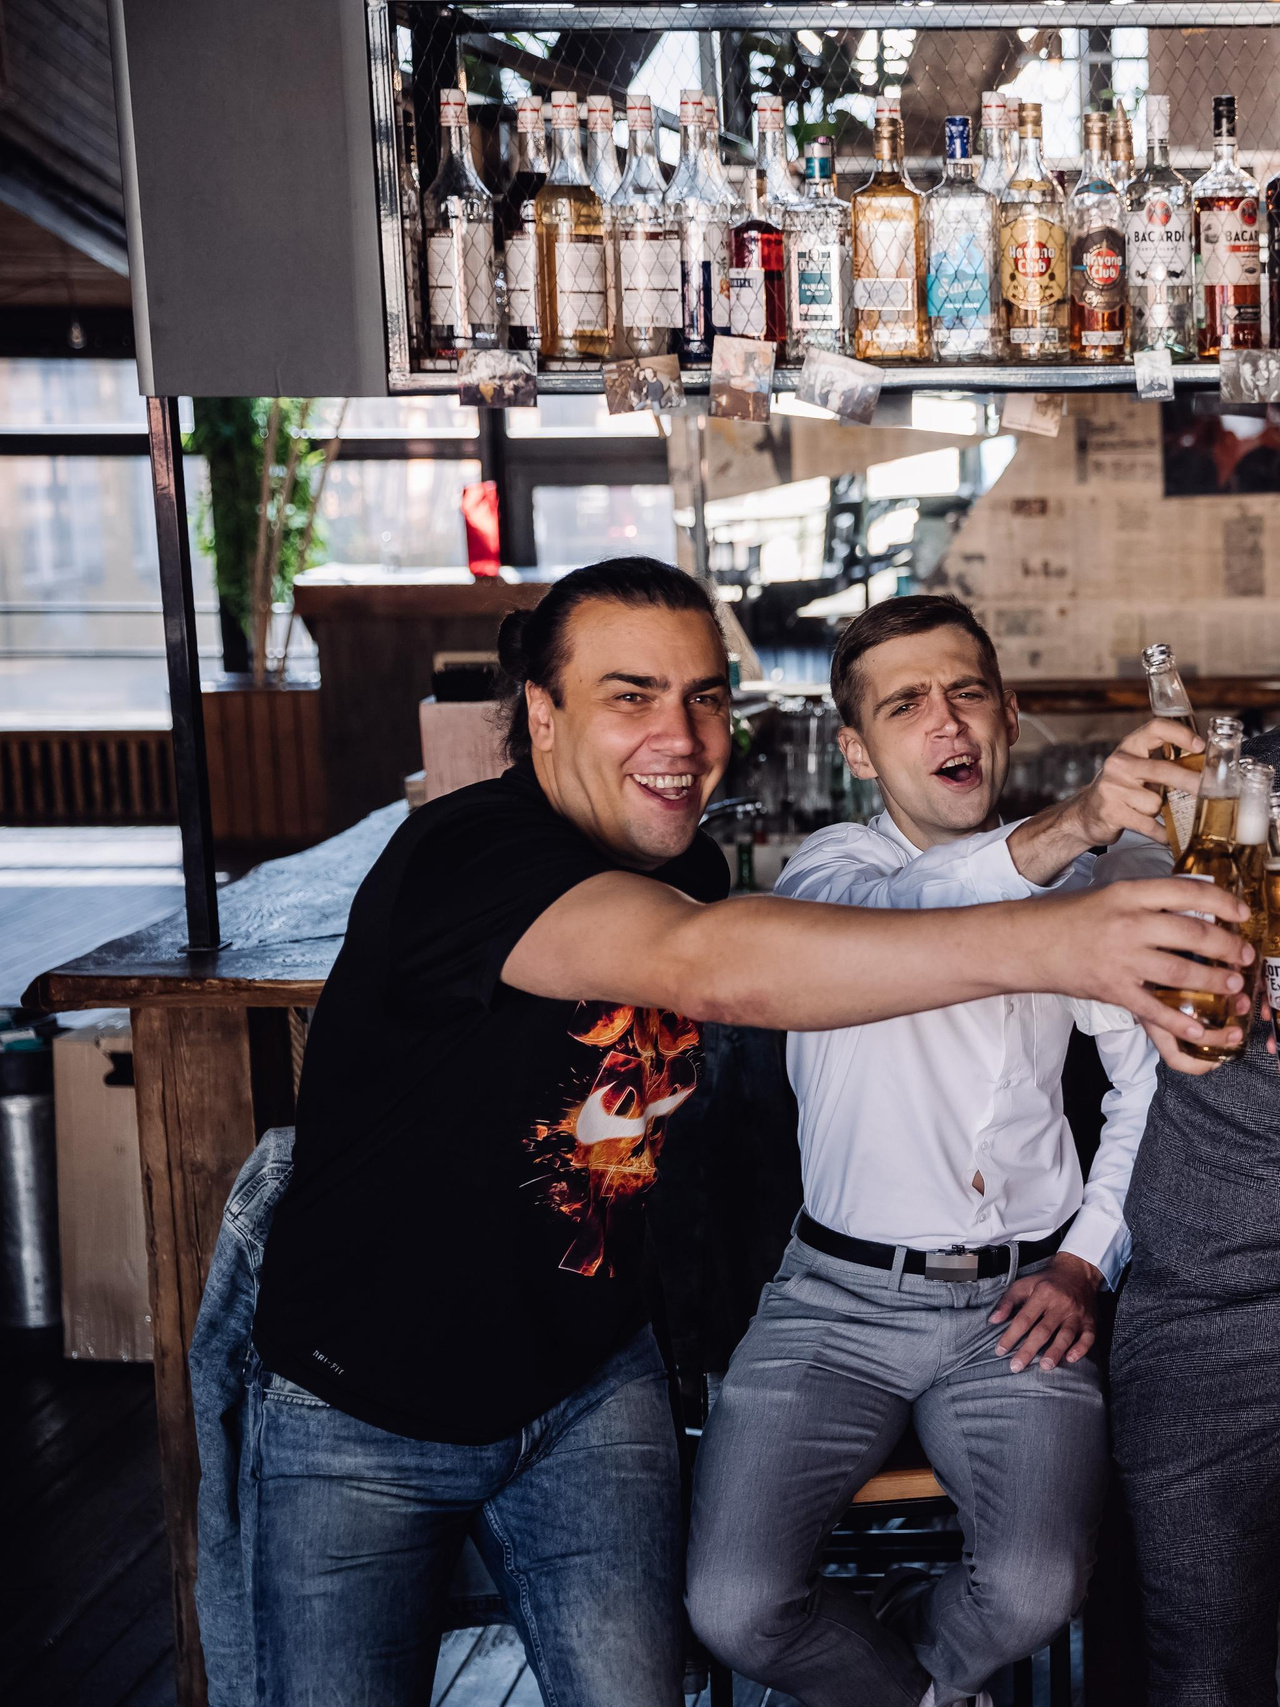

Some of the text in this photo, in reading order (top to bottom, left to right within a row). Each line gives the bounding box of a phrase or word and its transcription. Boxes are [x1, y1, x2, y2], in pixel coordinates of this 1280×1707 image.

[1226, 230, 1259, 242] BACAR
[1083, 253, 1122, 266] Havana
[1018, 260, 1046, 273] Club
[1091, 267, 1116, 278] Club
